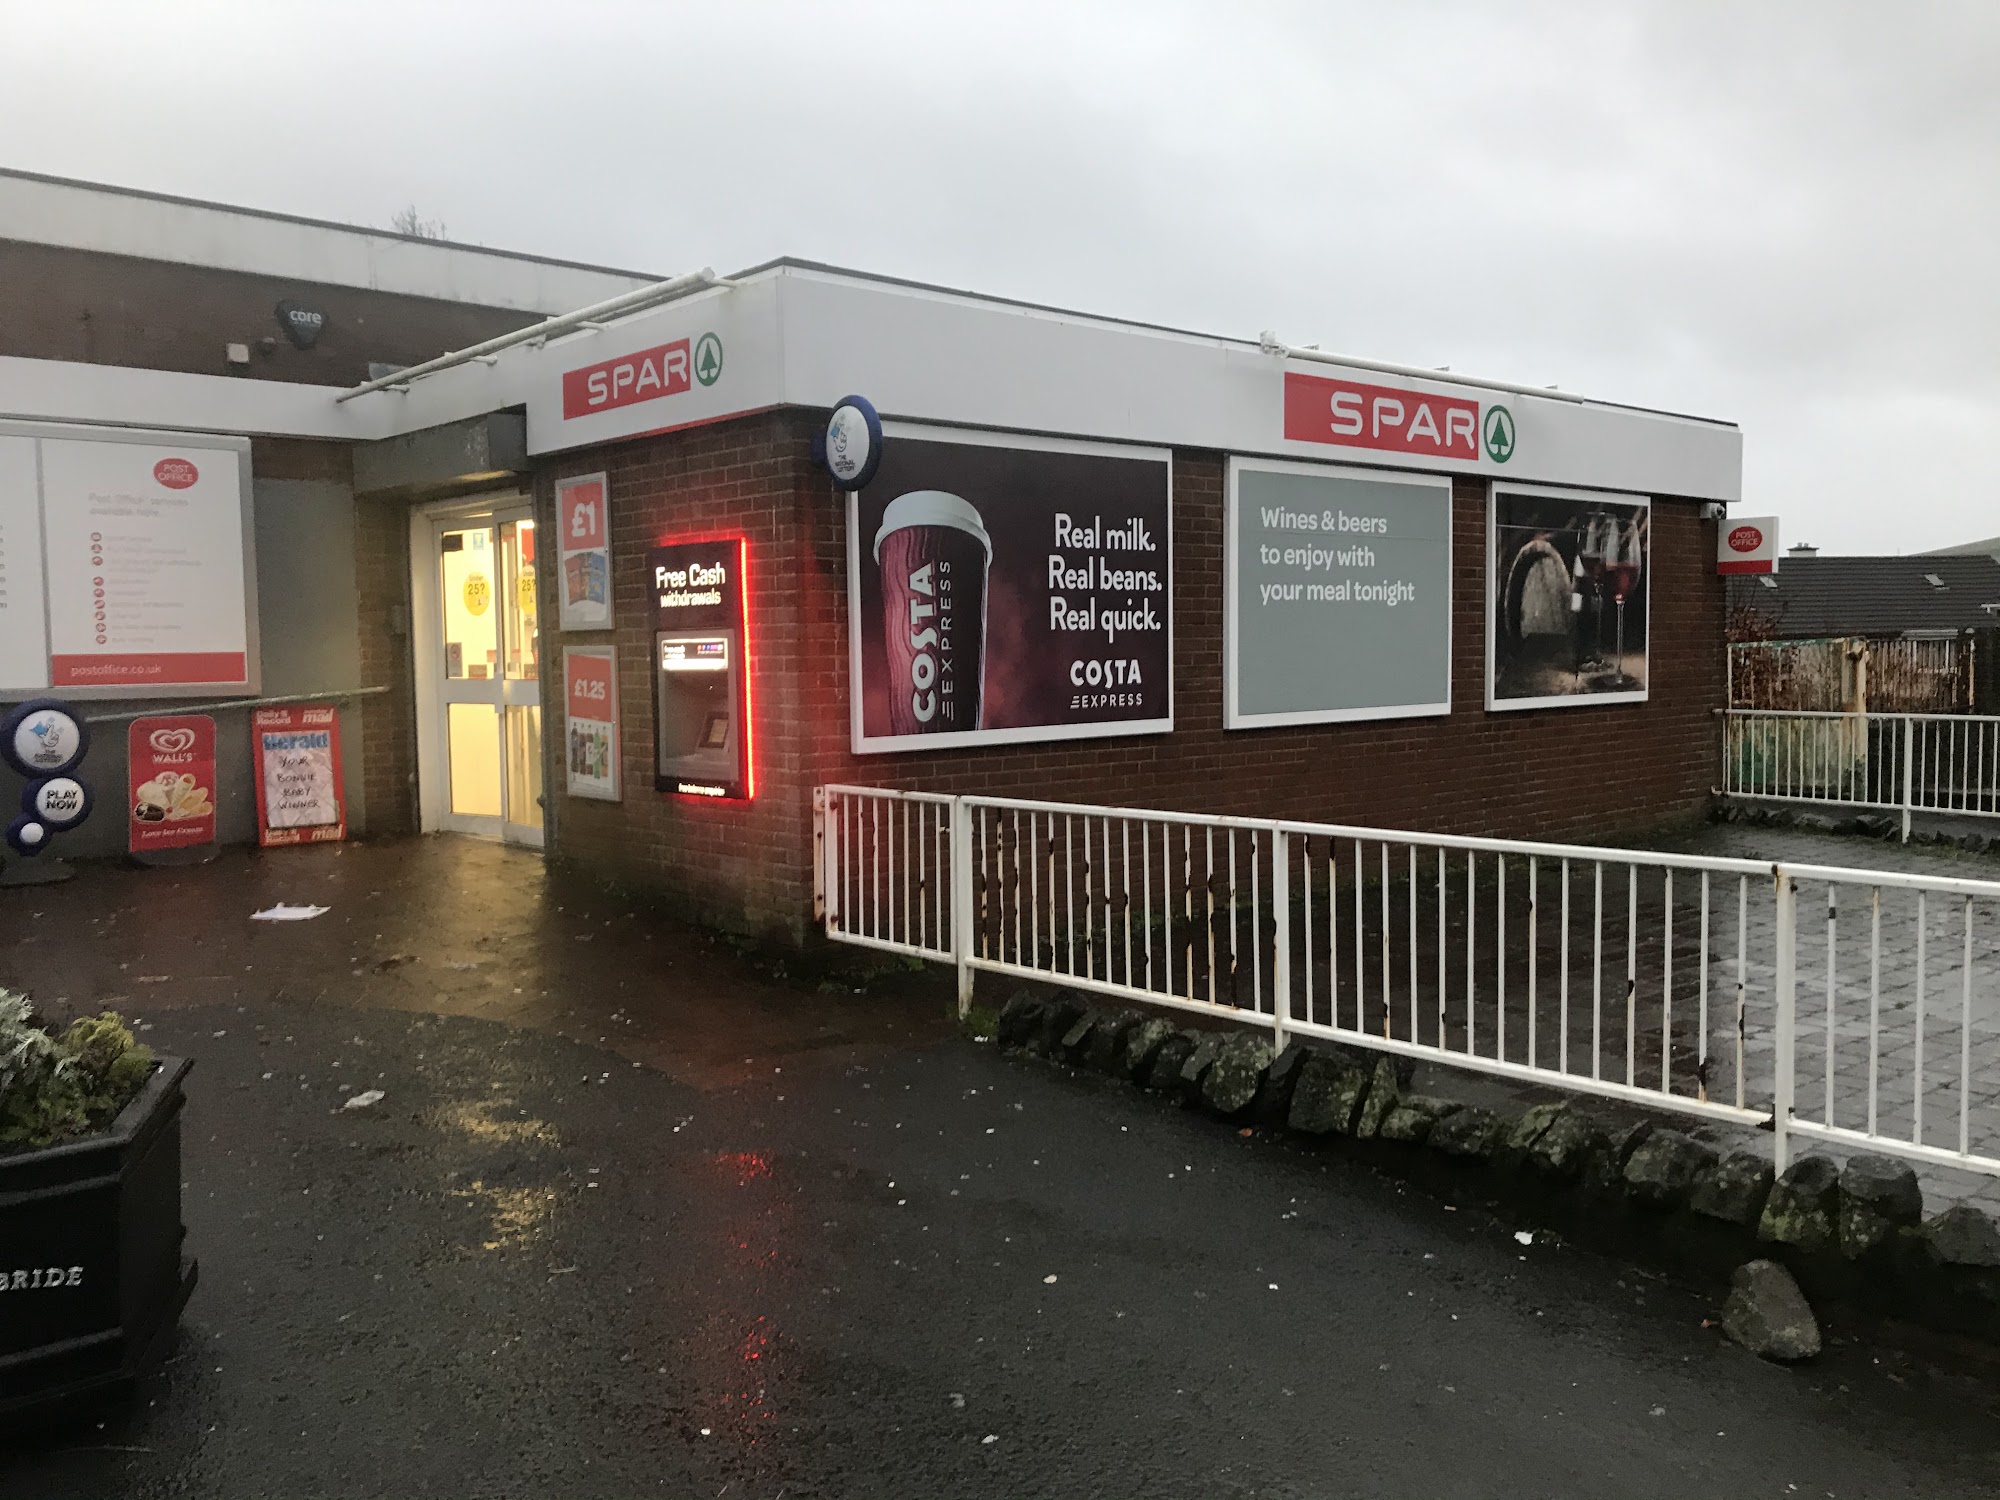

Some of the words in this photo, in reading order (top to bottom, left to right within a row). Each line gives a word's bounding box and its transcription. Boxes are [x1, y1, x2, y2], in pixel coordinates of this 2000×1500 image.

[588, 349, 688, 406] SPAR
[1330, 390, 1475, 450] SPAR
[157, 472, 194, 482] OFFICE
[163, 463, 190, 472] POST
[571, 500, 596, 538] £1
[1055, 513, 1101, 549] Real
[1106, 517, 1157, 551] milk.
[1261, 506, 1318, 530] Wines
[1321, 510, 1335, 531] &
[1338, 509, 1388, 533] beers
[1730, 538, 1759, 547] OFFICE
[1735, 530, 1756, 539] POST
[1260, 544, 1281, 565] to
[1284, 543, 1335, 571] enjoy
[1337, 545, 1376, 567] with
[655, 566, 687, 589] Free
[688, 561, 726, 586] Cash
[1048, 554, 1094, 590] Real
[1099, 556, 1163, 591] beans.
[468, 583, 486, 595] 25?
[660, 587, 722, 608] withdrawals
[1260, 583, 1304, 606] your
[1306, 579, 1350, 601] meal
[1353, 579, 1415, 607] tonight
[940, 560, 954, 694] EXPRESS
[1050, 596, 1096, 631] Real
[1101, 597, 1162, 644] quick.
[909, 562, 938, 722] COSTA
[71, 664, 162, 677] postoffice.co.uk
[1069, 659, 1143, 690] COSTA
[574, 678, 606, 700] £1.25
[1081, 692, 1143, 709] EXPRESS
[152, 753, 194, 765] WALL'S
[45, 800, 78, 810] NOW
[46, 790, 78, 800] PLAY
